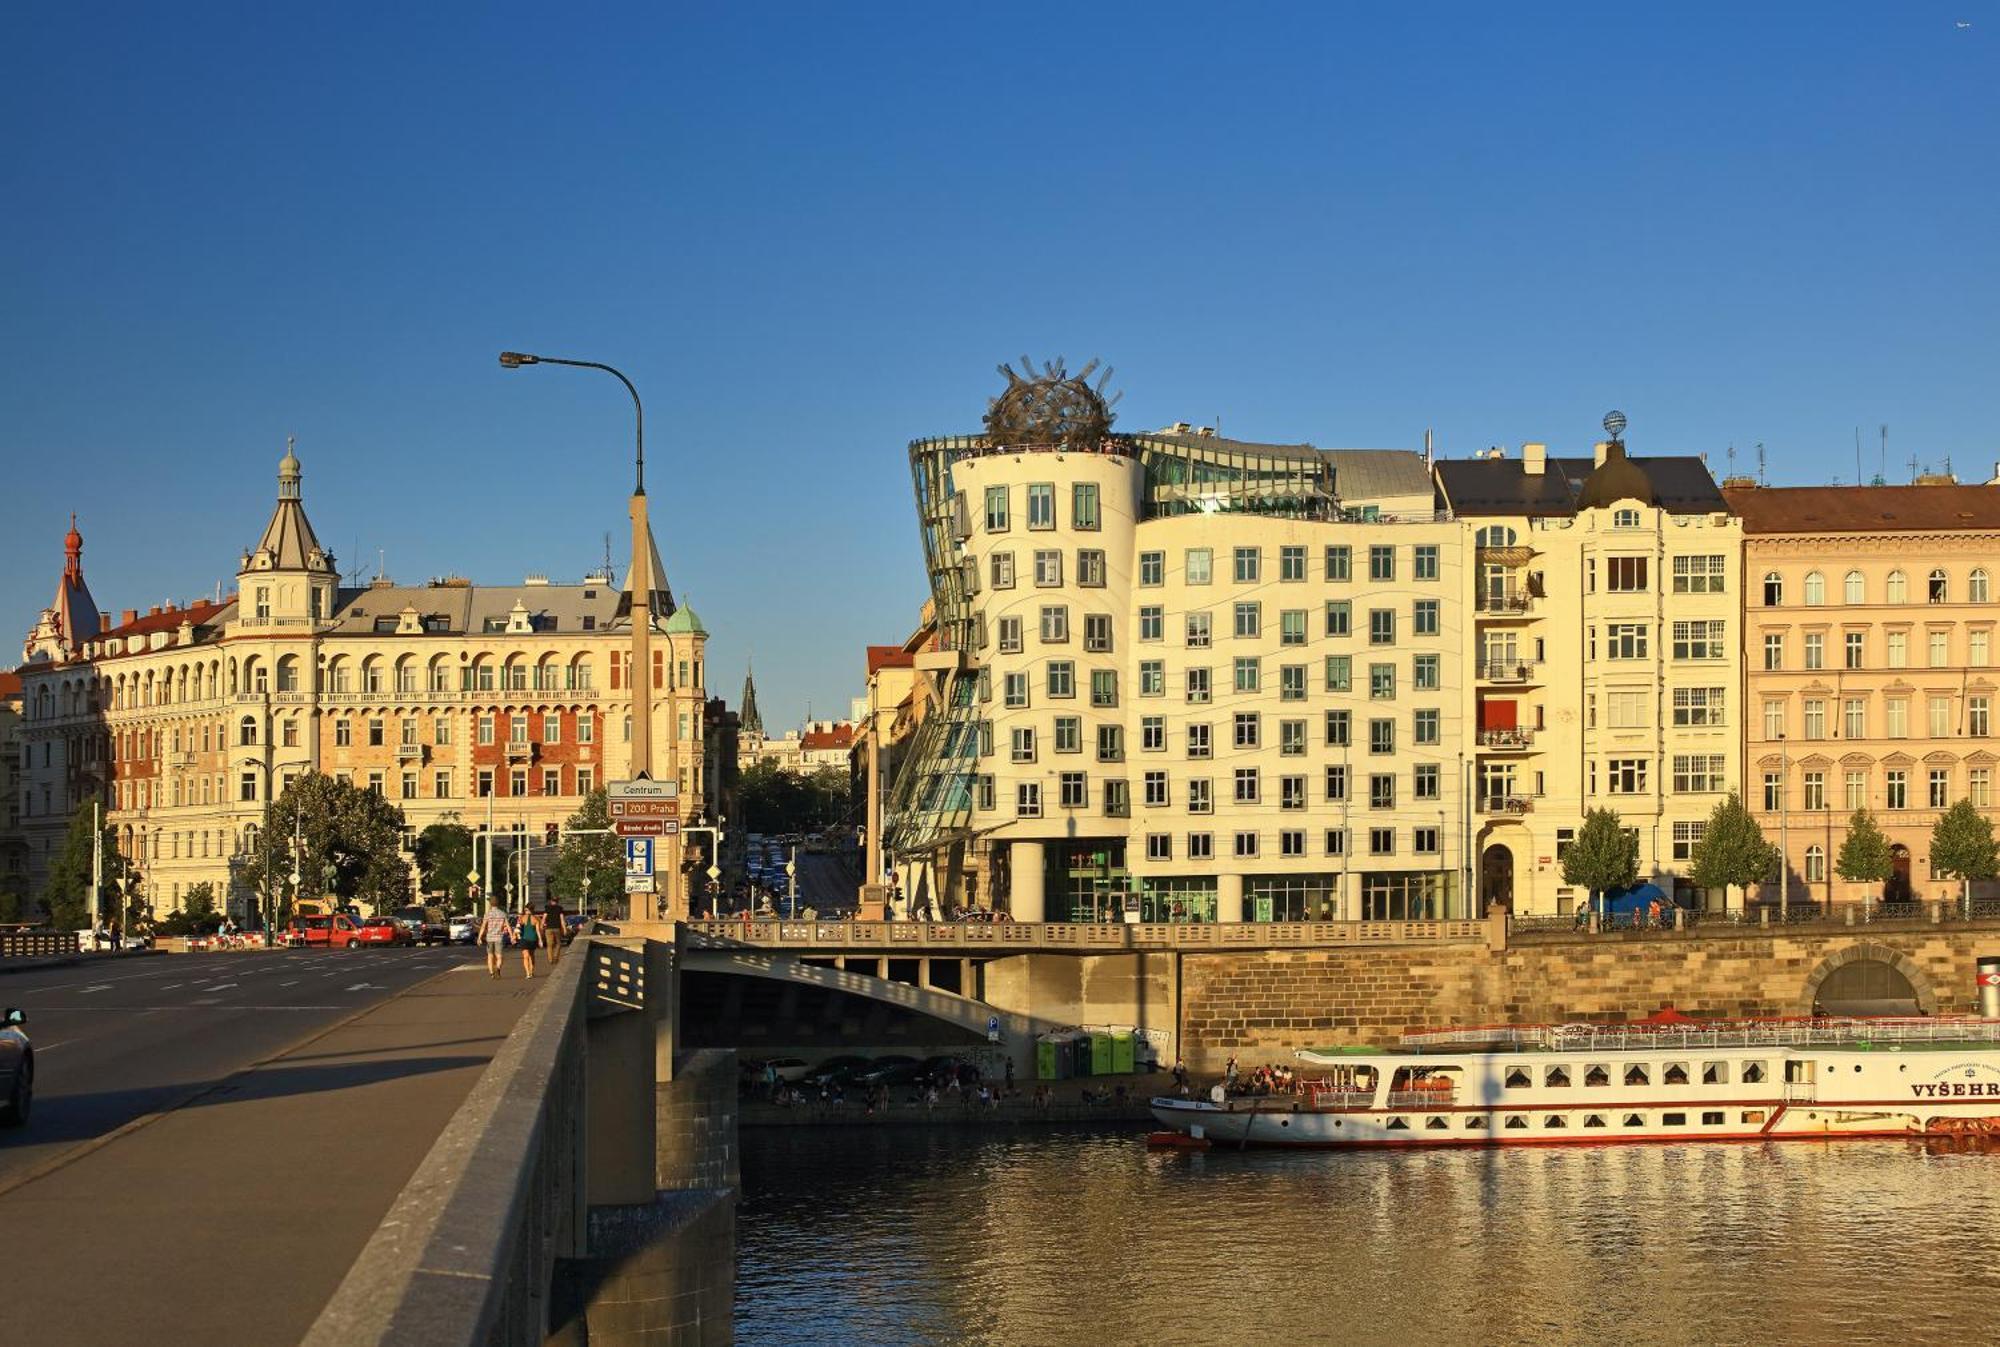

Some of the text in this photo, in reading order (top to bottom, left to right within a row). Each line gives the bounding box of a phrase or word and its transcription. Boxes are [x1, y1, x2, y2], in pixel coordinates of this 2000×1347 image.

[623, 786, 662, 794] Centrum
[650, 804, 675, 813] Praha
[1911, 1081, 2000, 1096] VYŠEHR
